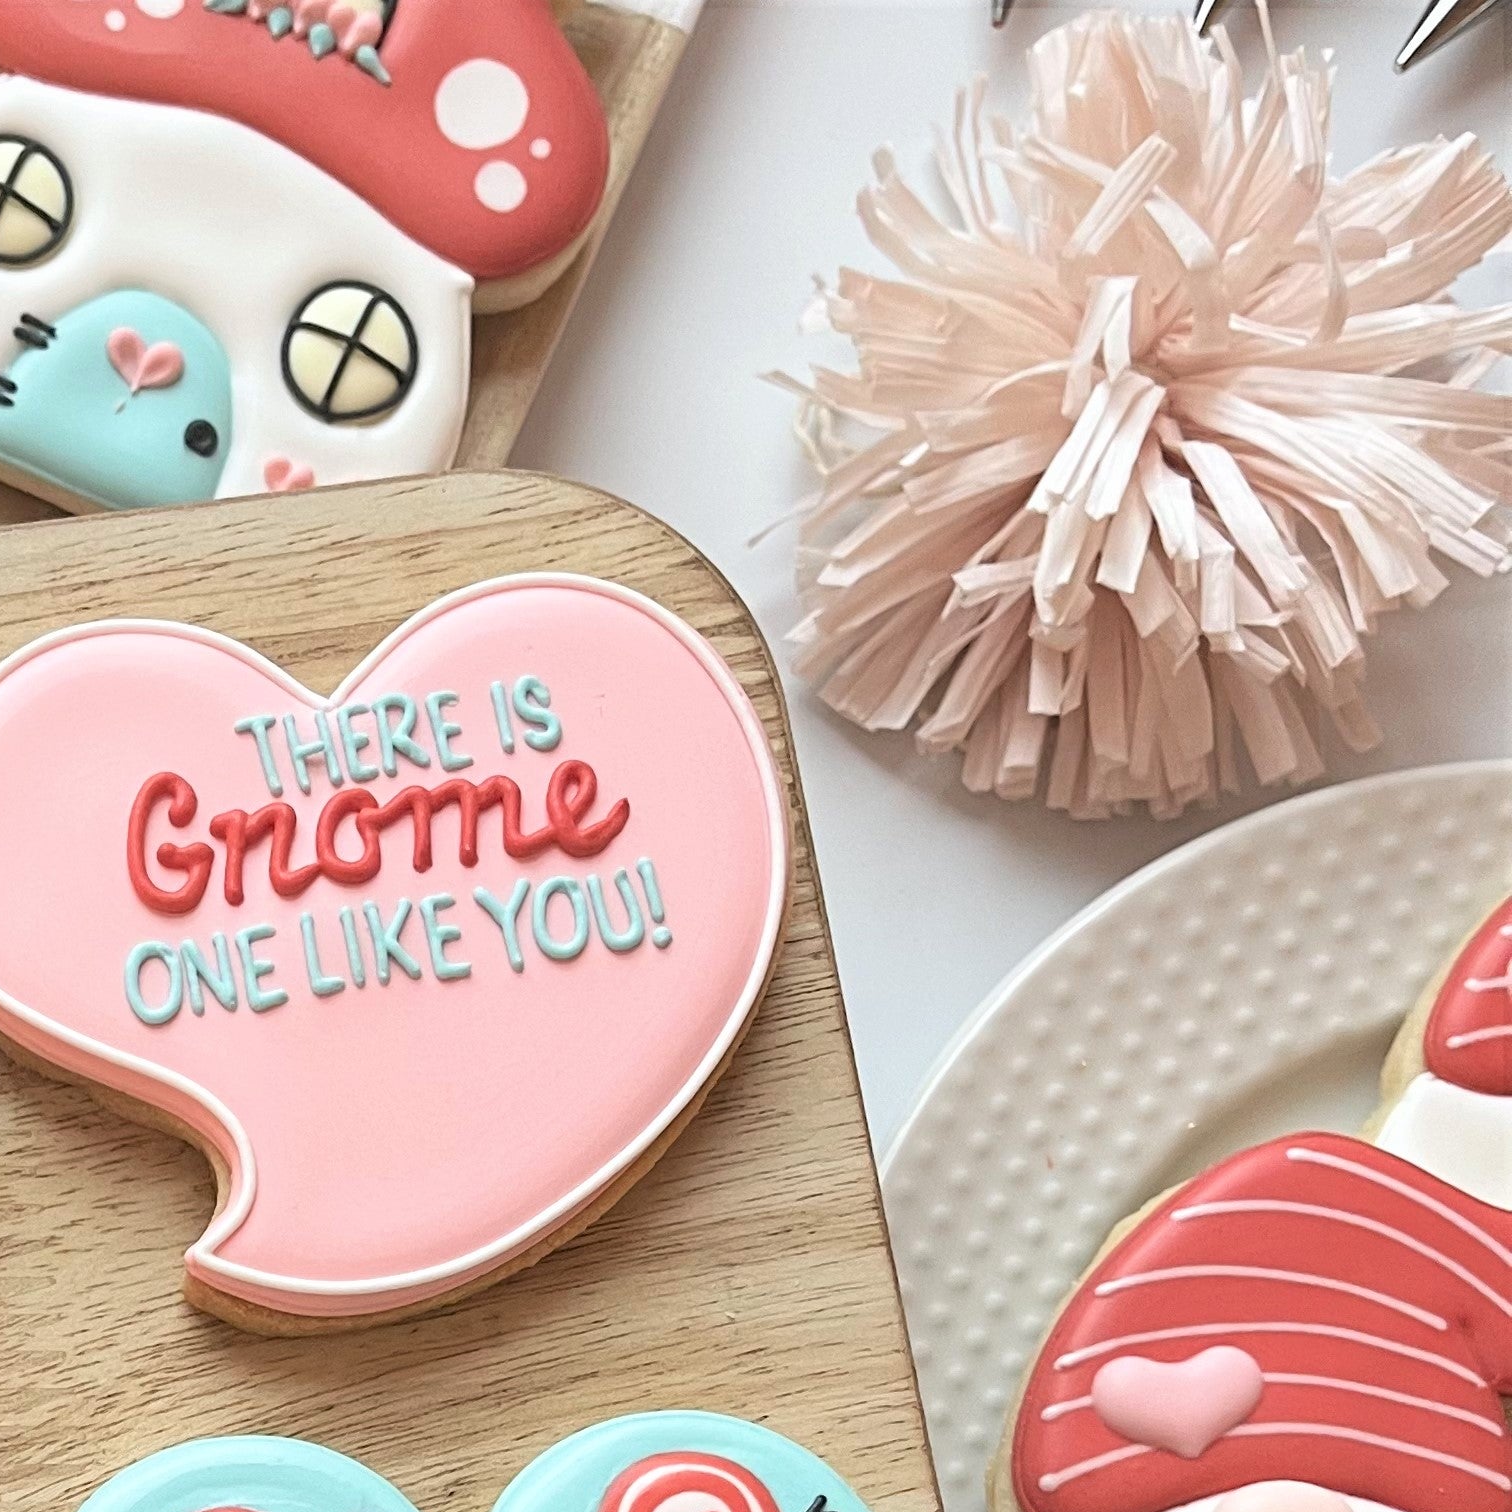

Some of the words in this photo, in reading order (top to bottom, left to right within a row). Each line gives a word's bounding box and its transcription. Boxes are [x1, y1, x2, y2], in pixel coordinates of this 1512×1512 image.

[234, 689, 473, 797] THERE
[489, 674, 564, 755] IS
[126, 758, 630, 915] Gnome
[123, 924, 289, 1025] ONE
[299, 892, 472, 997] LIKE
[473, 856, 674, 973] YOU!
